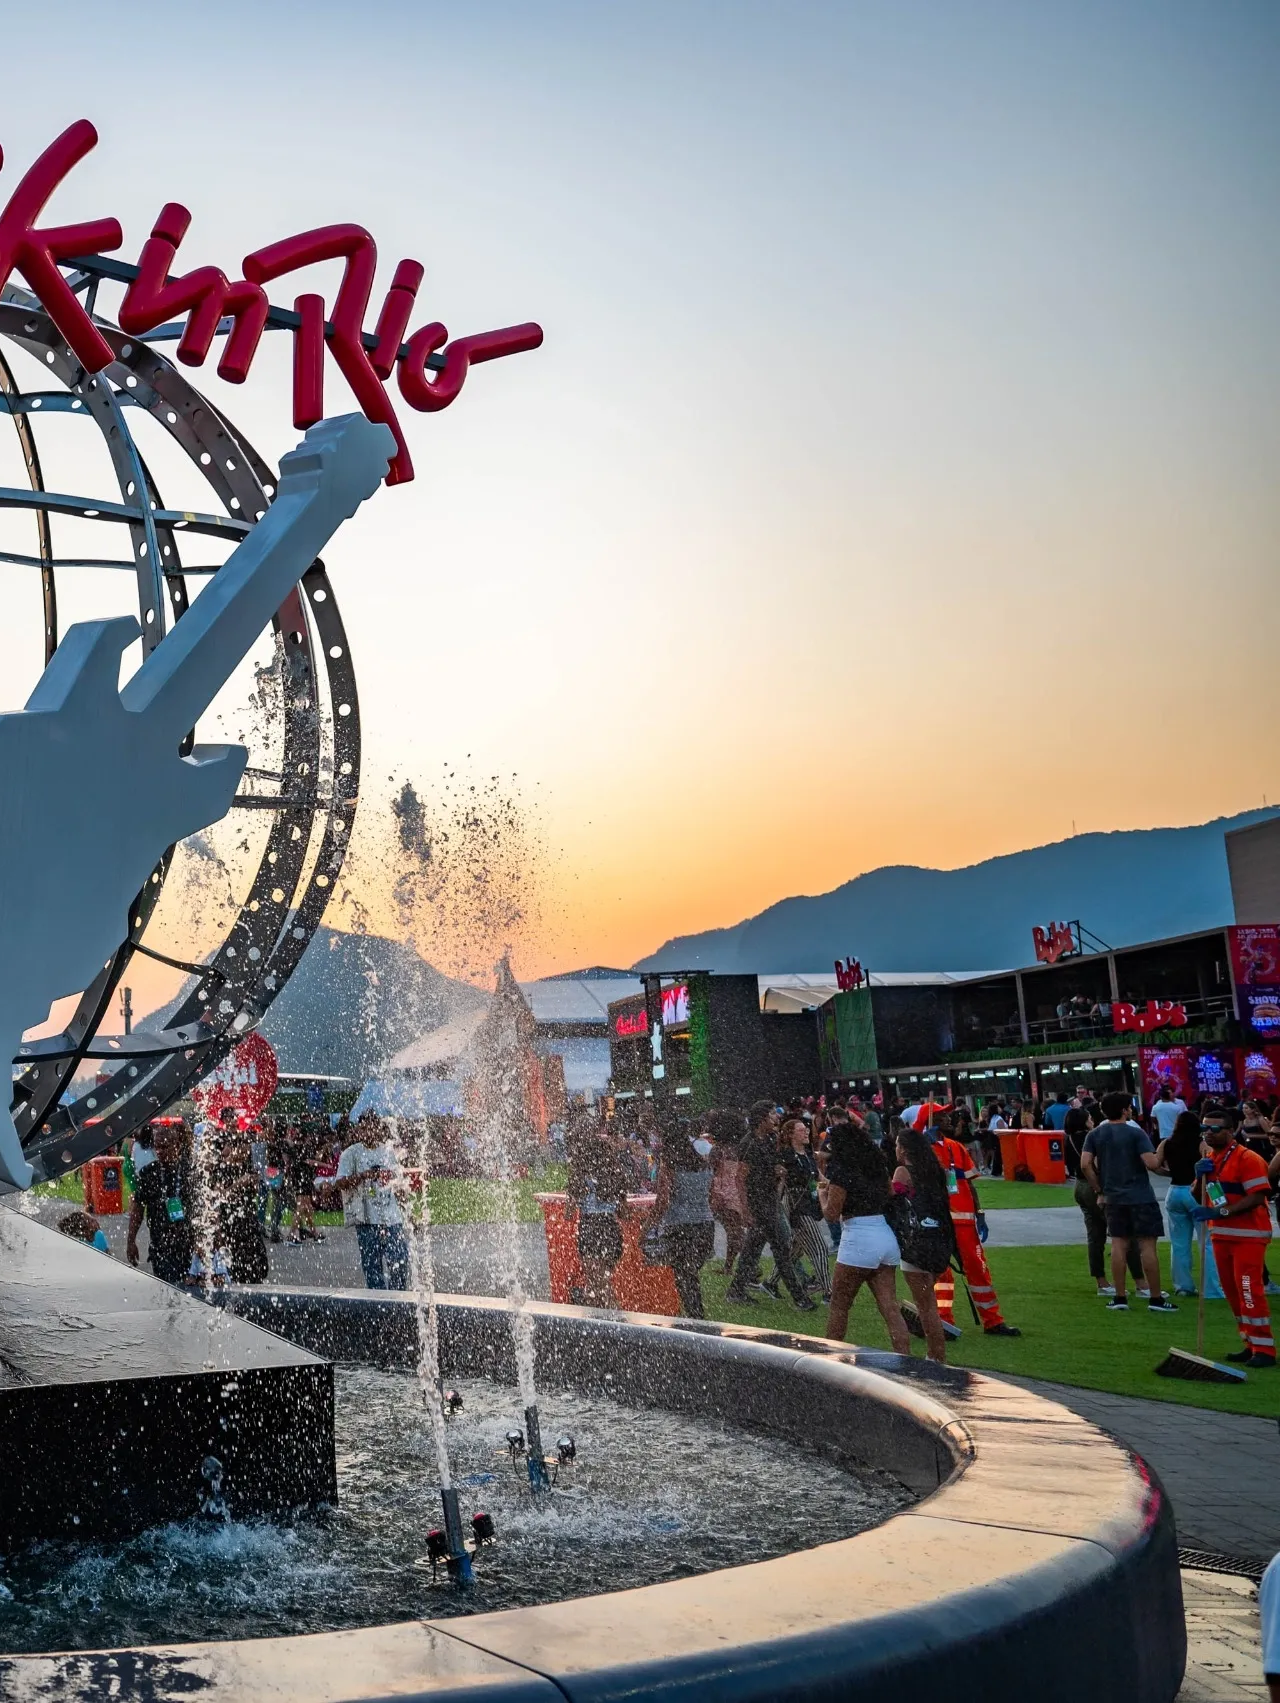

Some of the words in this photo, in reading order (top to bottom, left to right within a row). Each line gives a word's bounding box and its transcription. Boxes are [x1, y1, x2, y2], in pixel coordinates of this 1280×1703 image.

[118, 202, 270, 384] in
[243, 223, 544, 487] Rio
[1112, 1000, 1187, 1032] Bob's
